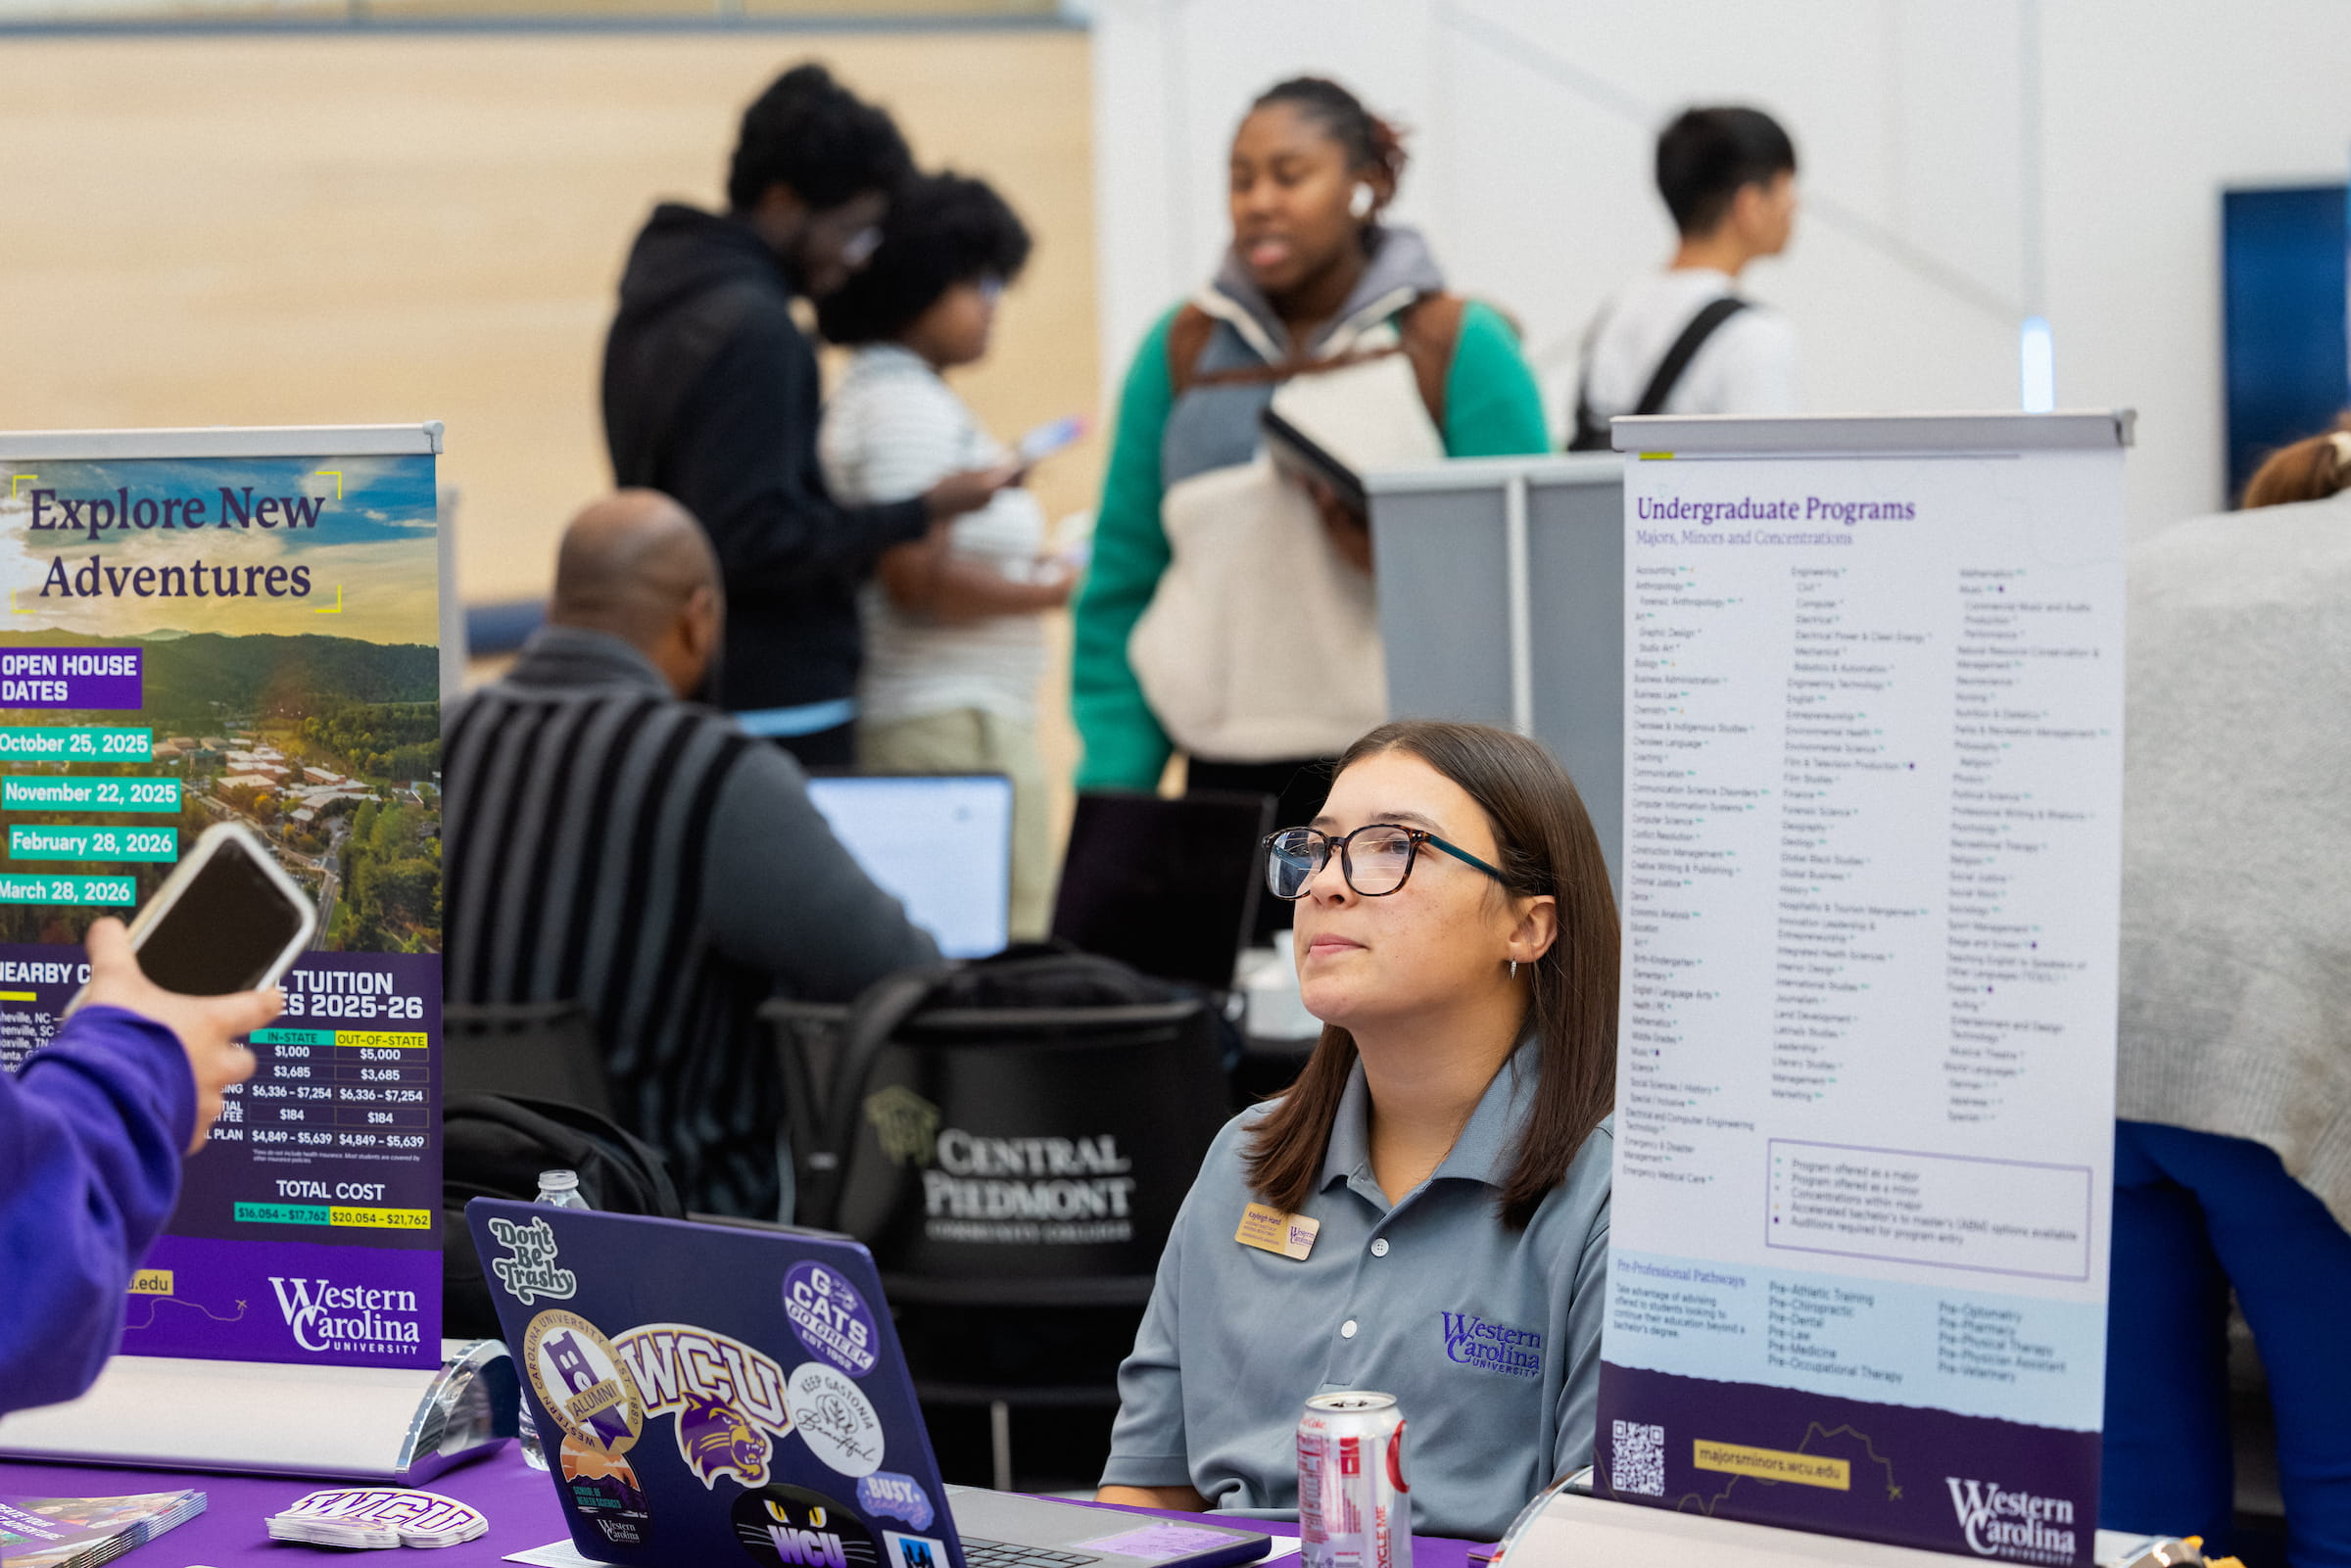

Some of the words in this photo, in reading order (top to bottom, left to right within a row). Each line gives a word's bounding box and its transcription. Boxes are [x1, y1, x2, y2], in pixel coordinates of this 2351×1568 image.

[29, 487, 206, 540] Explore
[217, 487, 326, 529] New
[1637, 497, 1800, 525] Undergraduate
[1805, 498, 1916, 525] Programs
[1636, 530, 1677, 547] Majors,
[1681, 530, 1724, 545] Minors
[1727, 531, 1752, 545] and
[1756, 530, 1853, 546] Concentrations
[39, 554, 312, 598] Adventures
[2, 654, 57, 676] OPEN
[62, 655, 137, 677] HOUSE
[2, 681, 69, 702] DATES
[0, 733, 65, 752] October
[70, 735, 97, 756] 25,
[102, 736, 149, 753] 2025
[5, 782, 92, 802] November
[97, 784, 125, 805] 22,
[129, 784, 177, 803] 2025
[13, 832, 87, 856] February
[92, 833, 120, 855] 28,
[126, 834, 173, 853] 2026
[52, 883, 79, 904] 28,
[84, 883, 130, 902] 2026
[292, 970, 394, 995] TUITION
[34, 1012, 51, 1024] NC
[311, 995, 424, 1020] 2025-26
[40, 1024, 55, 1037] SC
[267, 1031, 318, 1044] IN-STATE
[338, 1033, 425, 1047] OUT-OF-STATE
[274, 1045, 311, 1059] $1,000
[360, 1048, 402, 1062] $5,000
[273, 1066, 312, 1079] $3,685
[360, 1069, 401, 1082] $3,685
[252, 1085, 287, 1099] $6,336
[297, 1087, 332, 1100] $7,254
[340, 1087, 376, 1102] $6,336
[385, 1089, 424, 1104] $7,254
[223, 1112, 243, 1123] FEE
[280, 1109, 305, 1121] $184
[367, 1112, 394, 1124] $184
[214, 1128, 244, 1141] PLAN
[252, 1129, 288, 1144] $4,849
[297, 1131, 333, 1146] $5,639
[339, 1133, 376, 1147] $4,849
[386, 1135, 425, 1150] $5,639
[936, 1128, 1131, 1175] CENTRAL
[1792, 1159, 1830, 1174] Program
[1835, 1163, 1868, 1175] offered
[1893, 1169, 1920, 1181] major
[276, 1179, 332, 1199] TOTAL
[335, 1183, 386, 1201] COST
[924, 1169, 1136, 1221] PIEDMONT
[1792, 1174, 1830, 1189] Program
[1834, 1177, 1868, 1190] offered
[1893, 1184, 1919, 1195] minor
[1791, 1189, 1862, 1205] Concentrations
[1865, 1197, 1893, 1208] within
[1895, 1199, 1923, 1212] major
[1791, 1204, 1847, 1218] Accelerated
[238, 1208, 278, 1219] $16,054
[289, 1210, 327, 1222] $17,762
[332, 1212, 377, 1223] $20,054
[387, 1214, 429, 1226] $21,762
[492, 1219, 554, 1255] Don't
[1791, 1217, 1835, 1232] Auditions
[1838, 1222, 1877, 1236] required
[1879, 1225, 1892, 1236] for
[1895, 1229, 1934, 1244] program
[1939, 1232, 1964, 1245] entry
[515, 1246, 545, 1268] Be
[495, 1259, 575, 1302] Trashy
[268, 1277, 418, 1326] Western
[1769, 1280, 1830, 1301] Pre-Athletic
[1834, 1285, 1875, 1308] Training
[793, 1280, 868, 1349] CATS
[1768, 1296, 1855, 1318] Pre-Chiropractic
[293, 1305, 420, 1352] Carolina
[540, 1312, 604, 1345] UNIVERSITY
[1442, 1311, 1541, 1350] Western
[1768, 1310, 1825, 1328] Pre-Dental
[790, 1305, 811, 1325] GO
[816, 1322, 870, 1364] GREEK
[1768, 1324, 1811, 1341] Pre-Law
[333, 1341, 418, 1355] UNIVERSITY
[525, 1326, 545, 1391] CAROLINA
[1448, 1333, 1540, 1370] Carolina
[1767, 1339, 1838, 1359] Pre-Medicine
[2009, 1336, 2054, 1358] Therapy
[1472, 1357, 1540, 1378] UNIVERSITY
[1767, 1353, 1858, 1377] Pre-Occupational
[1861, 1364, 1903, 1385] Therapy
[615, 1328, 790, 1431] WCU
[572, 1381, 618, 1418] ALUMNI
[800, 1374, 822, 1396] KEEP
[825, 1376, 874, 1430] GASTONIA
[542, 1395, 596, 1449] WESTERN
[1699, 1448, 1841, 1481] majorsminors.wcu.edu
[867, 1477, 914, 1503] BUSY
[296, 1489, 477, 1533] WCU
[1944, 1477, 2075, 1528] Western
[1374, 1504, 1387, 1528] ME
[767, 1524, 847, 1568] WCU
[1965, 1513, 2076, 1556] Carolina
